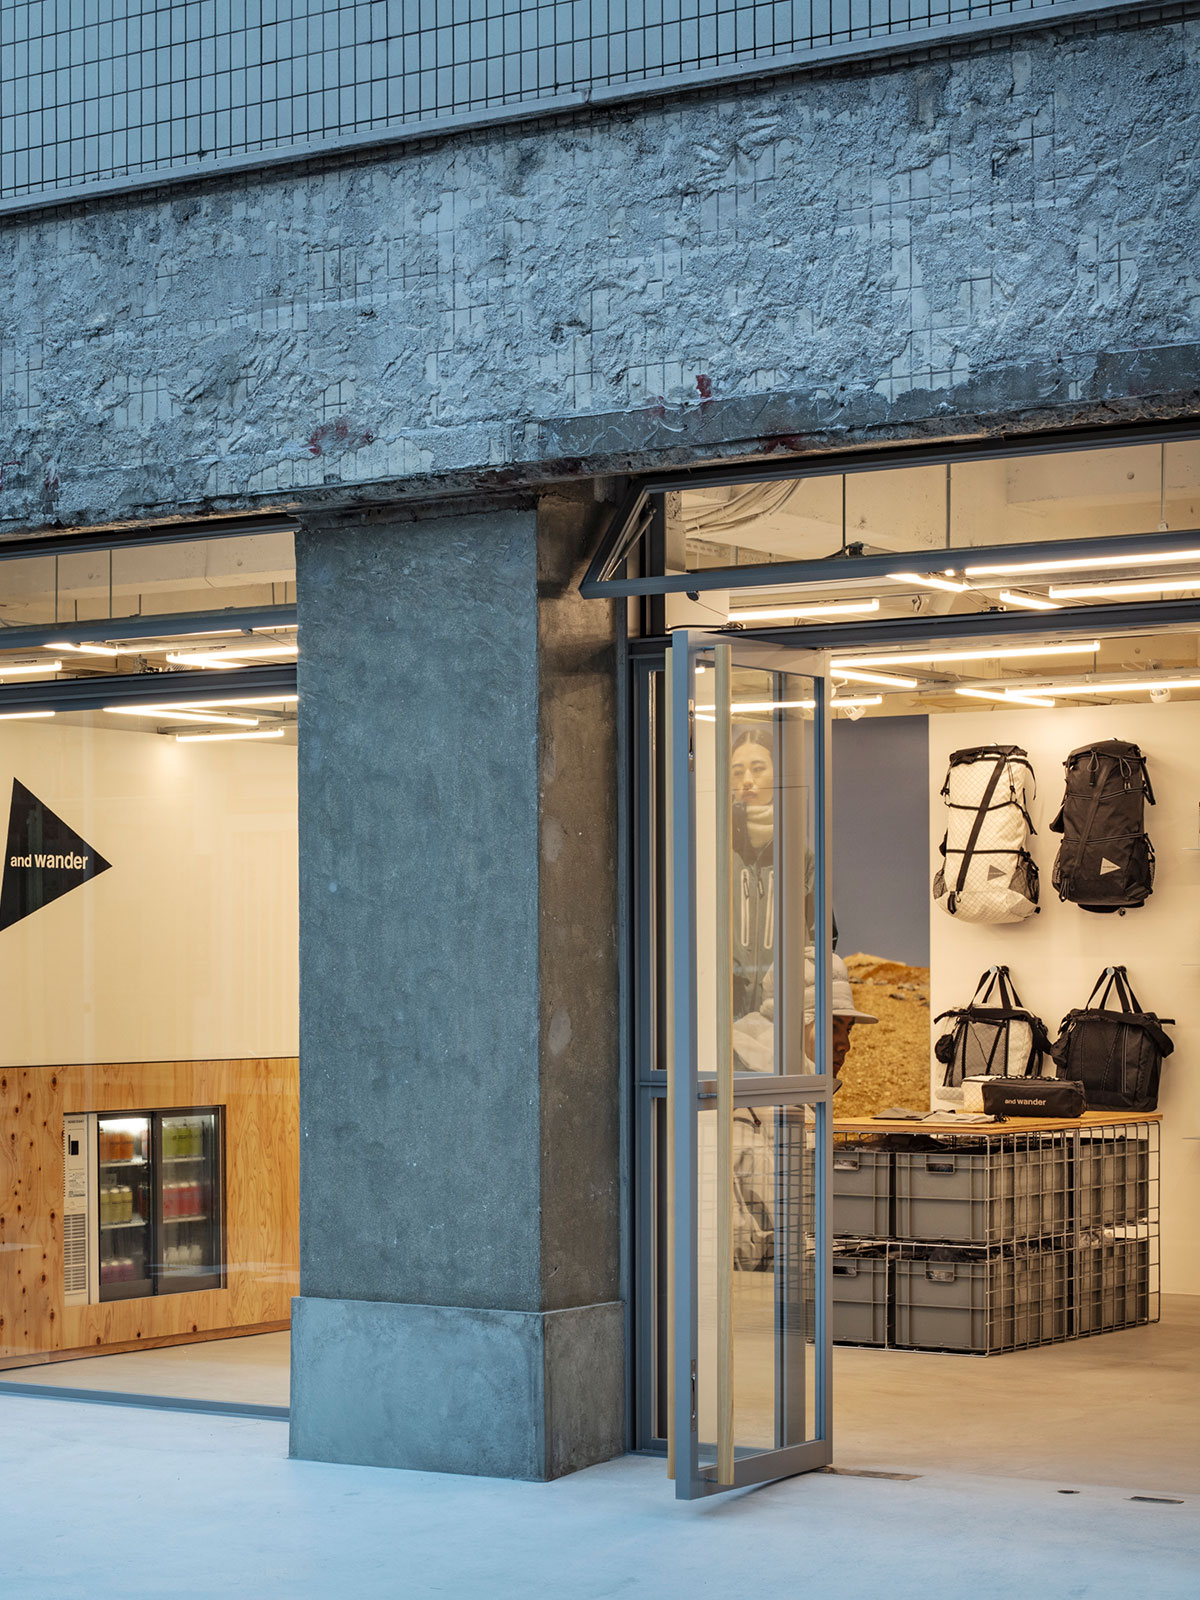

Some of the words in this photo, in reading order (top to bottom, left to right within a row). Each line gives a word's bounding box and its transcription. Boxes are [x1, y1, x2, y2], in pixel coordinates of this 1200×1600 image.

[10, 854, 32, 868] and
[34, 852, 88, 869] wander
[1017, 1098, 1047, 1106] wander
